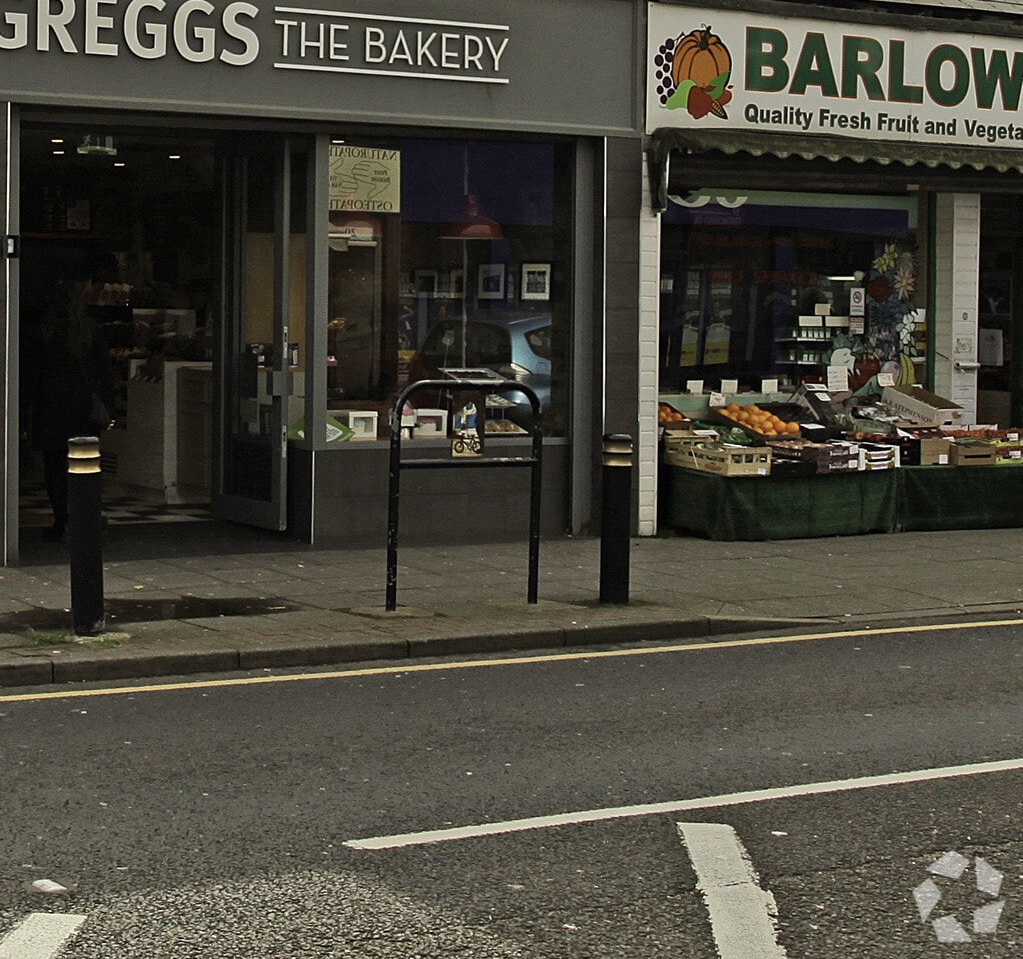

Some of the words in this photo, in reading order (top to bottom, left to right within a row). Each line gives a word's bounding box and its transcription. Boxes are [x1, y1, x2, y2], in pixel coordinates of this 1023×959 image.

[274, 19, 350, 61] THE
[364, 26, 509, 72] BAKERY
[744, 25, 1023, 112] BARLOW
[744, 103, 814, 131] Quality
[819, 108, 872, 130] Fresh
[877, 112, 920, 134] Fruit
[925, 117, 957, 137] and
[964, 119, 1023, 143] Vegeta
